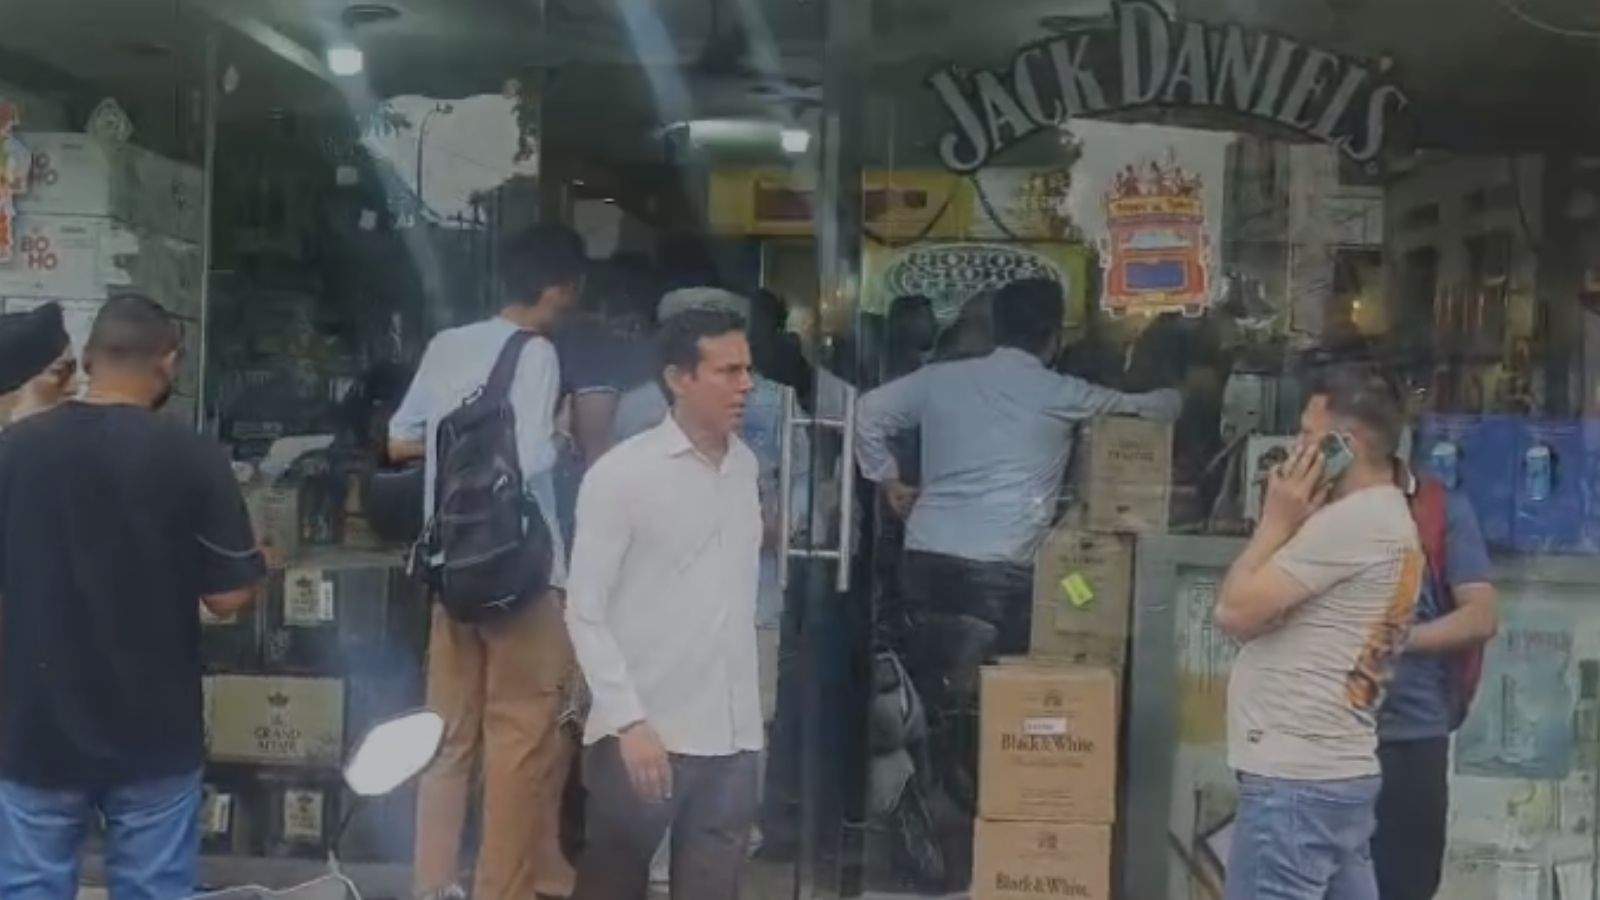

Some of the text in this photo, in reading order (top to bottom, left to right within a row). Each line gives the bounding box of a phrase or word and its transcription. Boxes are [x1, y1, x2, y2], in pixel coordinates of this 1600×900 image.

[927, 0, 1407, 173] JACK DANIEL'S
[29, 253, 57, 270] HO
